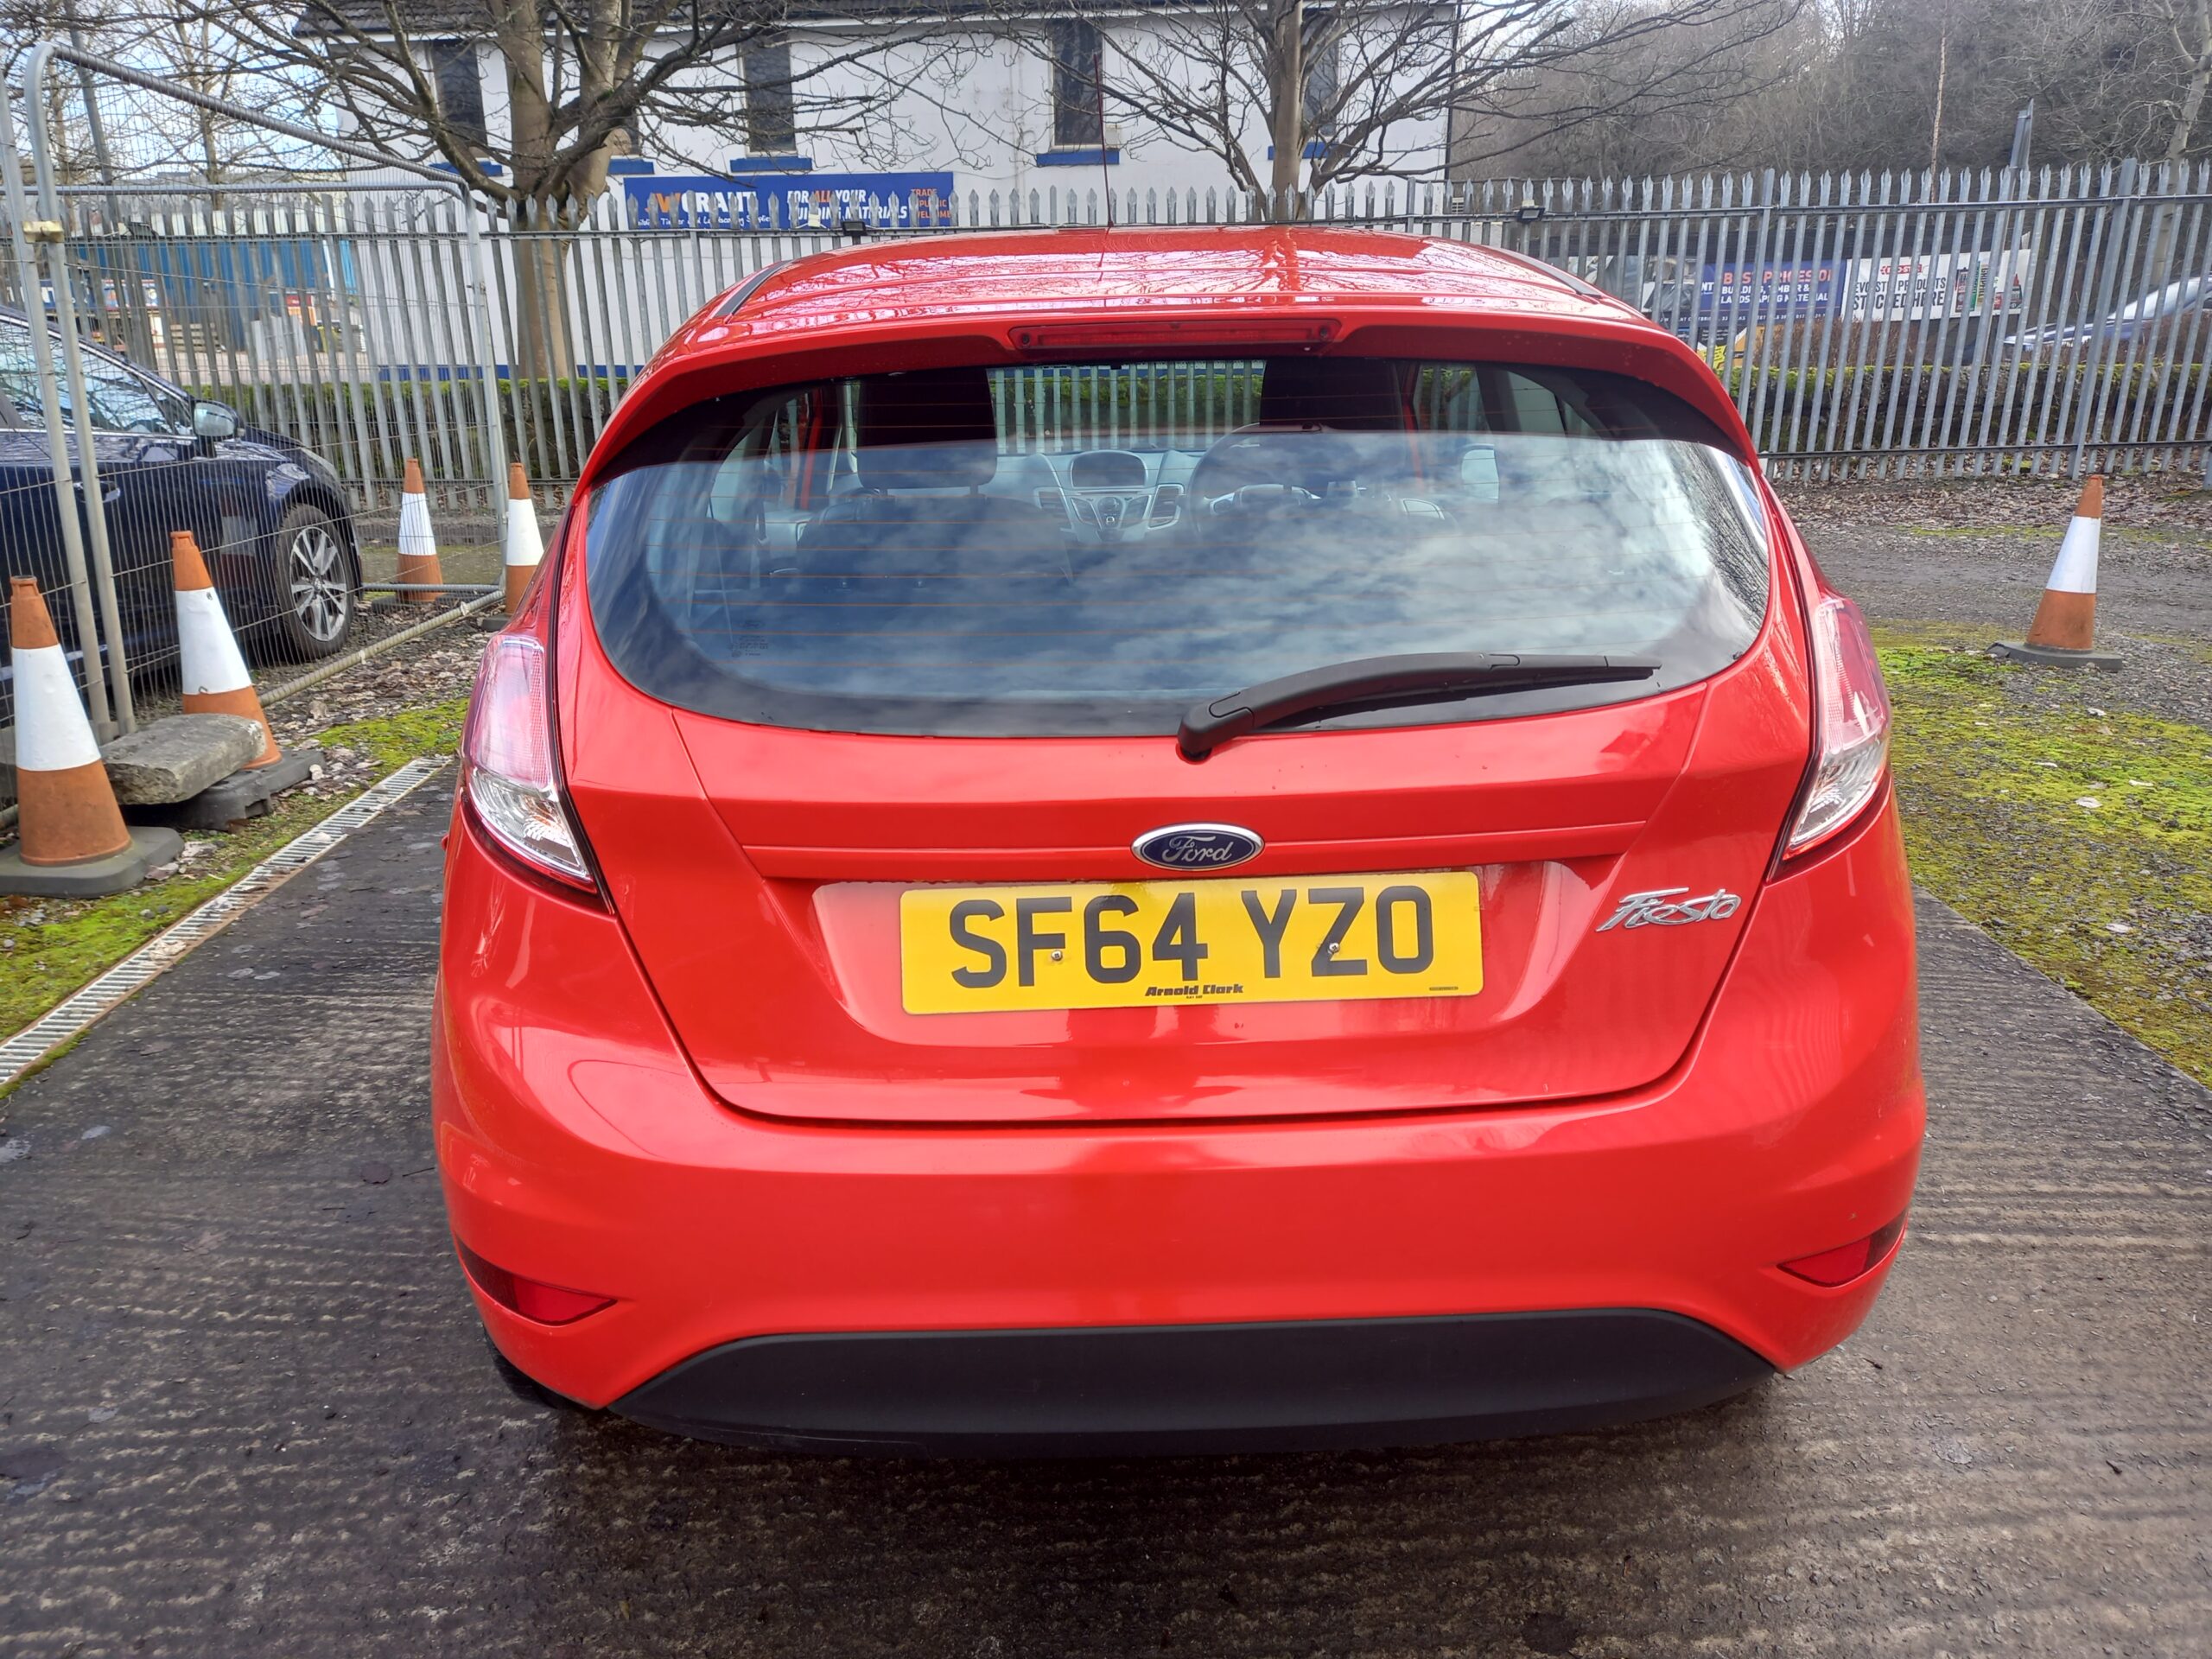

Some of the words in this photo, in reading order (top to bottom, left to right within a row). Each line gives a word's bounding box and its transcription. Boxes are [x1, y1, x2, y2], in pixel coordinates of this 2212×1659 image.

[1162, 836, 1234, 862] Ford
[1596, 887, 1742, 932] Fiesta
[949, 892, 1209, 989] SF64
[1241, 885, 1433, 979] YZO
[1145, 986, 1199, 996] Arnold
[1202, 983, 1244, 995] Clark
